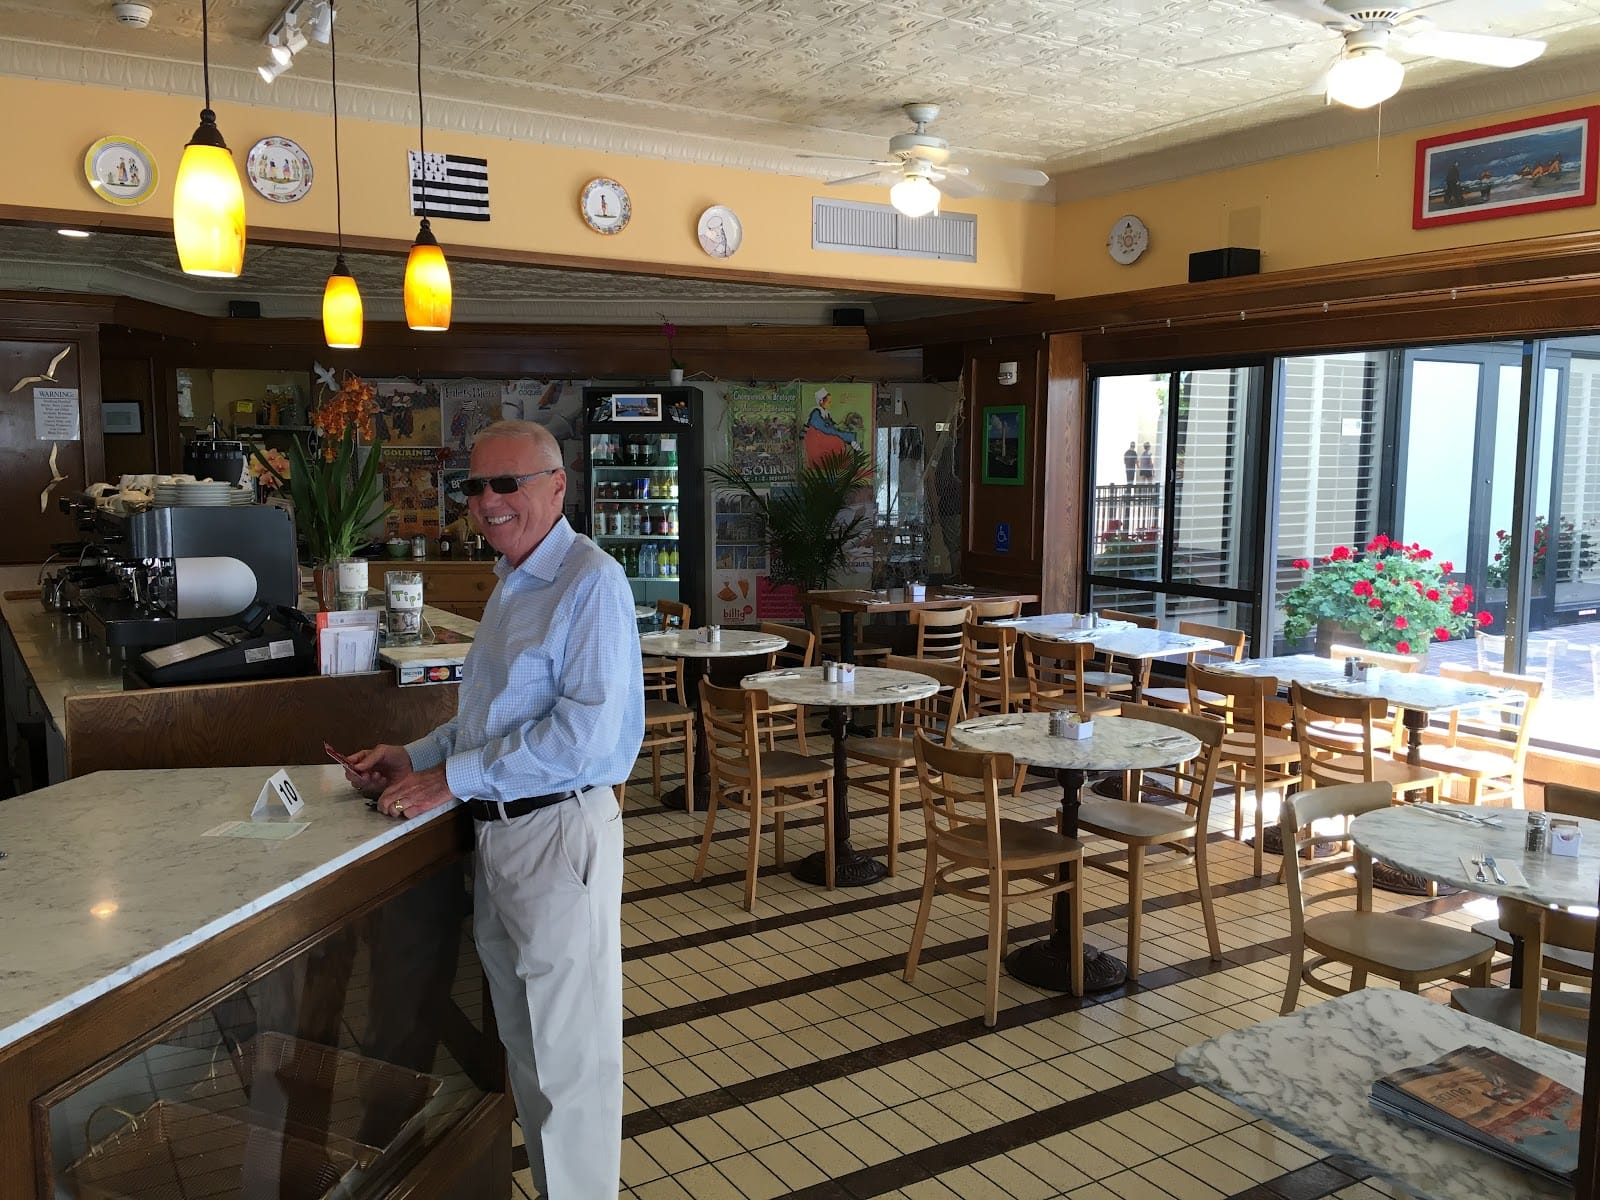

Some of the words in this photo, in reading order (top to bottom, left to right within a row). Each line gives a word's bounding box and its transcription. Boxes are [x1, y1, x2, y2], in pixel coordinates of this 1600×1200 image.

[742, 463, 795, 476] GOURIN
[392, 590, 421, 606] Tips
[723, 608, 745, 621] billig
[279, 780, 298, 805] 10
